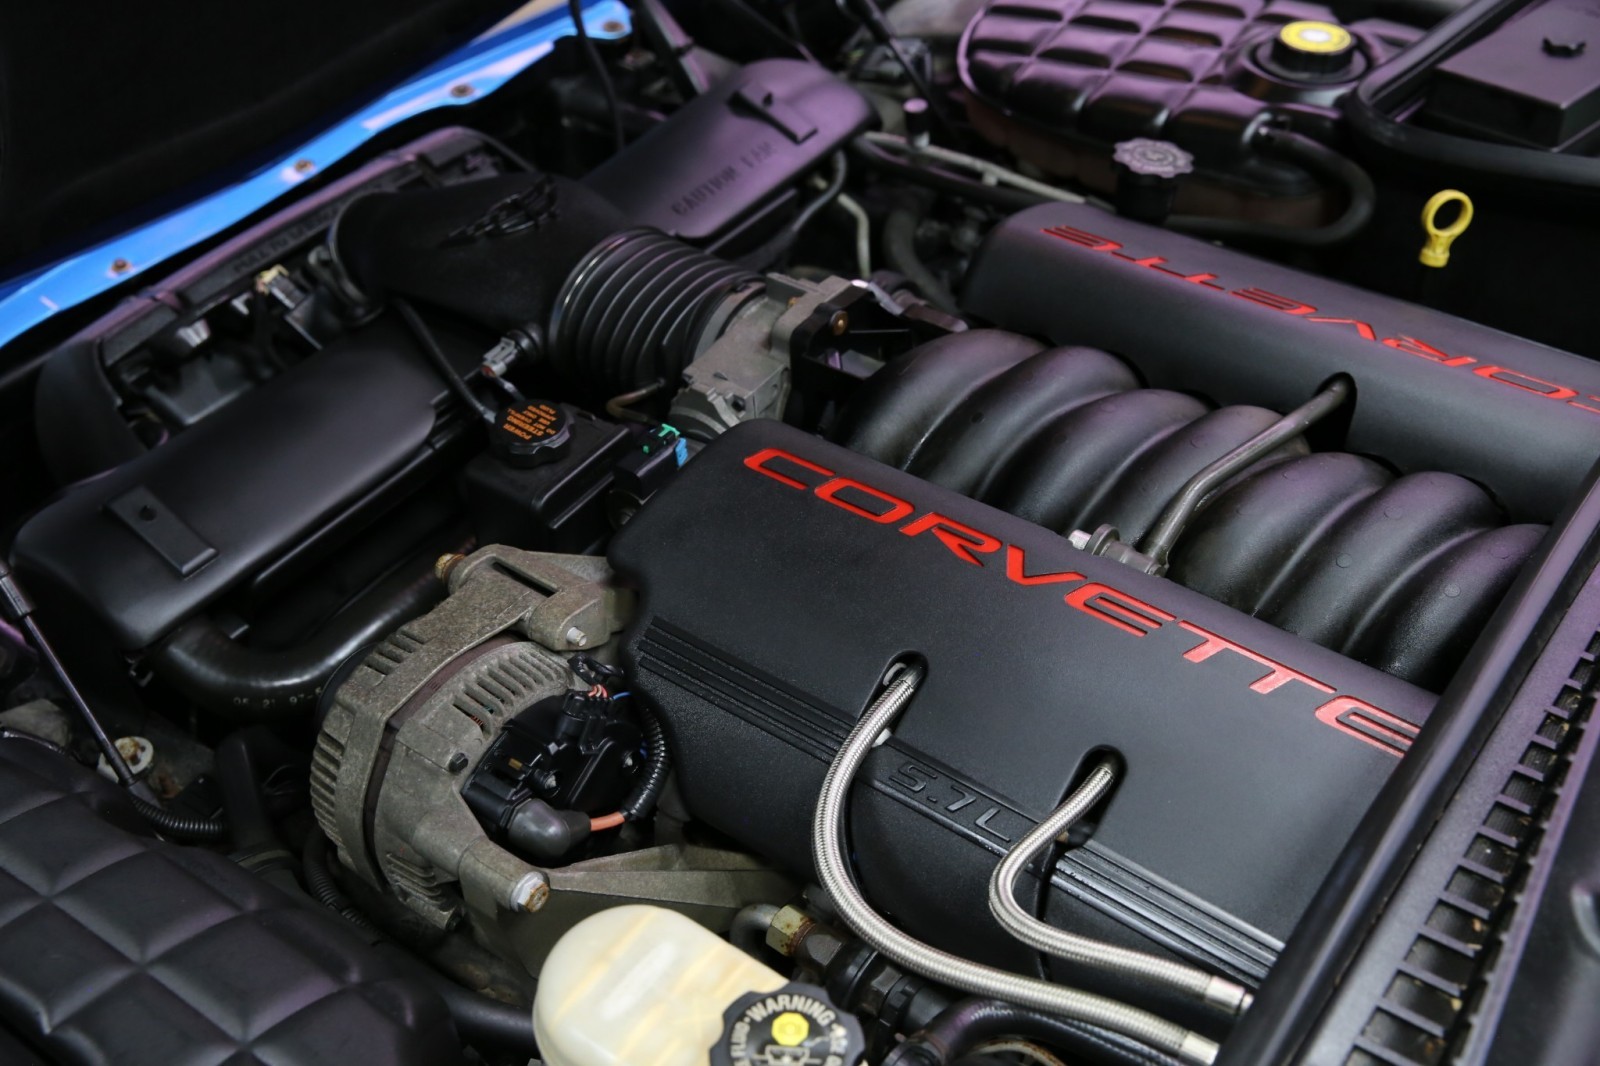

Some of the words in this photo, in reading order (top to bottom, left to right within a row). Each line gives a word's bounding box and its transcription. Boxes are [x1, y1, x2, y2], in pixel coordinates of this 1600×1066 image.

[503, 423, 532, 440] POWER
[507, 415, 544, 436] STEERING
[744, 448, 1420, 758] CORVETTE
[888, 763, 1011, 843] 5.7L
[746, 994, 836, 1026] WARNING
